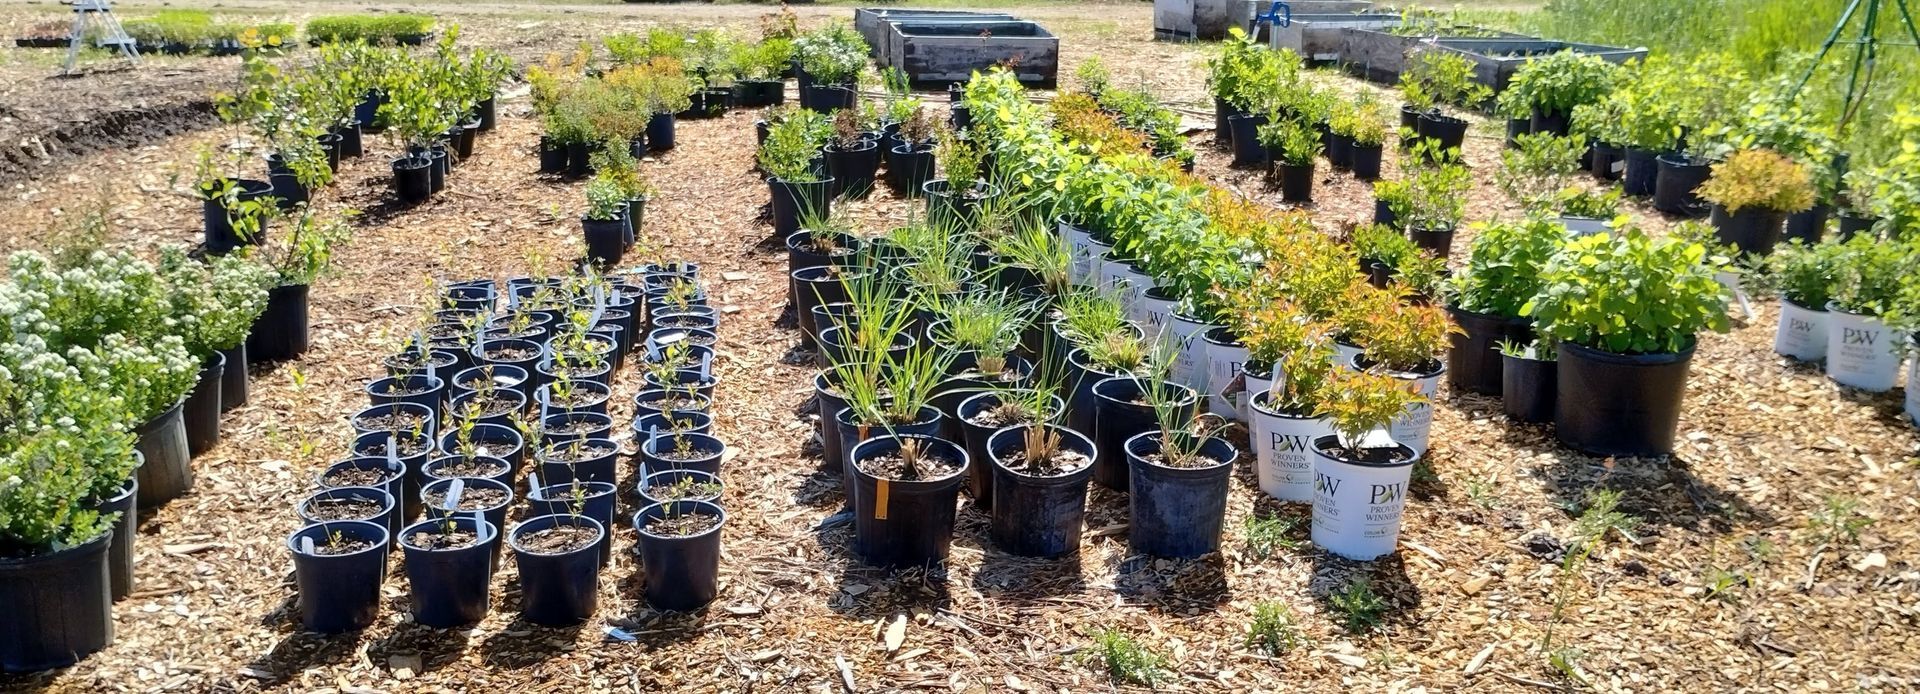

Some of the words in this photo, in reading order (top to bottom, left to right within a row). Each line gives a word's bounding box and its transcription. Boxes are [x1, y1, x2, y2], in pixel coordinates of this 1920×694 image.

[1842, 327, 1880, 345] PW
[1271, 431, 1310, 453] PW
[1273, 452, 1306, 462] PROVEN
[1368, 481, 1406, 504] PW
